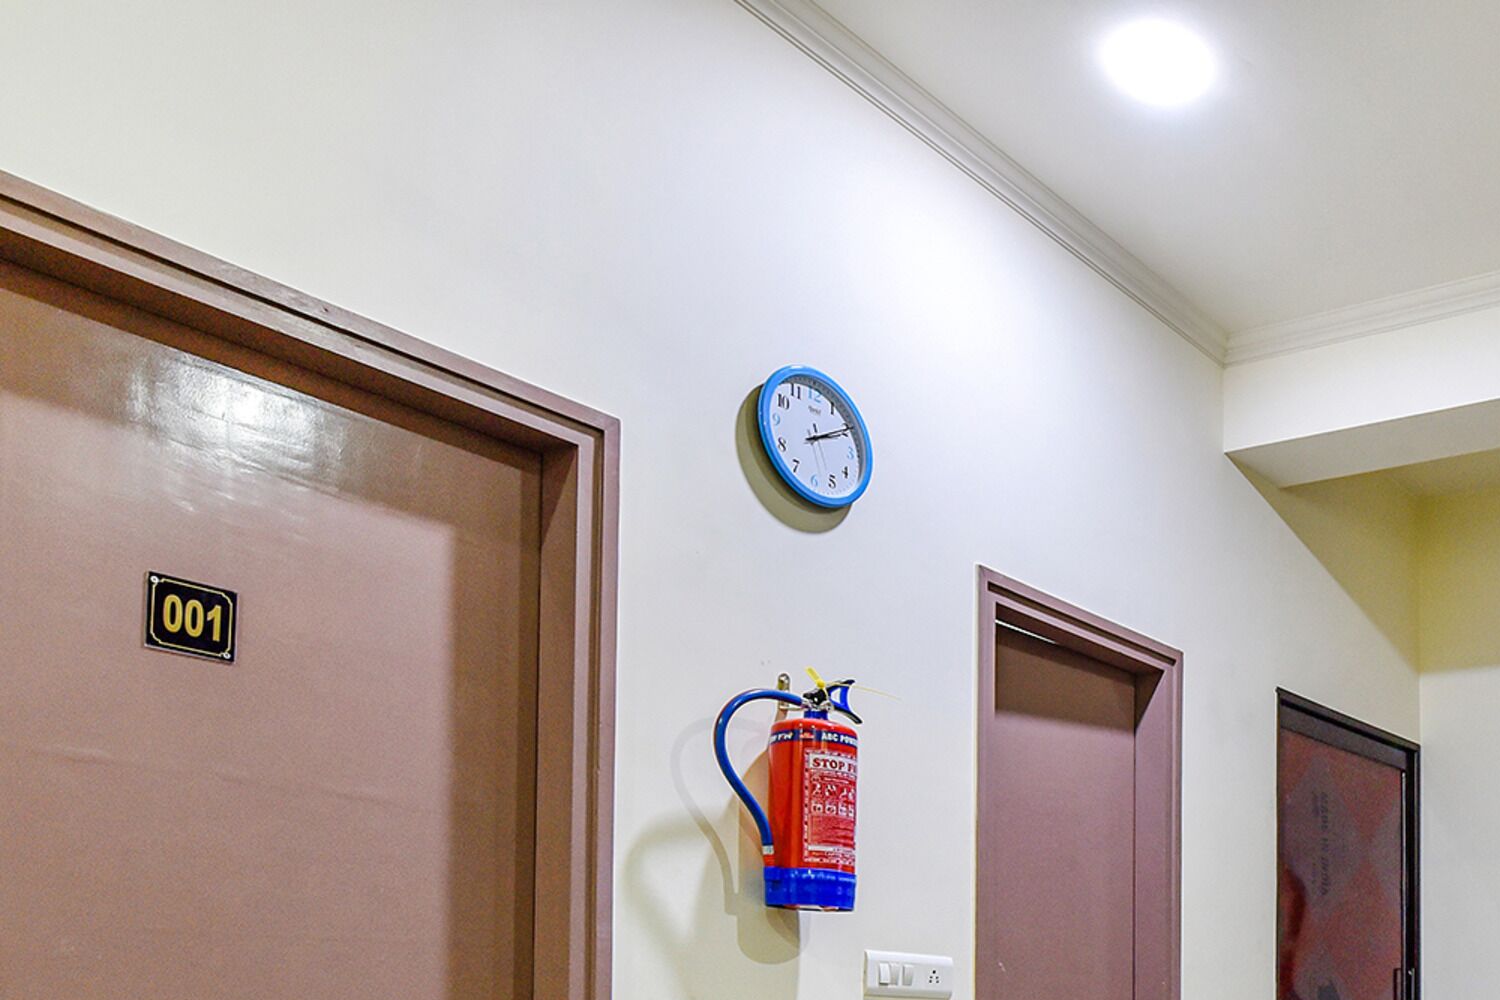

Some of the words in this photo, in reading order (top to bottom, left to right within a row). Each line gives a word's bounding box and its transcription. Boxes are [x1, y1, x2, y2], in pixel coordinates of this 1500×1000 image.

[790, 383, 801, 400] 11
[778, 393, 790, 410] 10
[830, 401, 836, 415] 1
[772, 412, 781, 426] 9
[778, 437, 787, 452] 8
[847, 446, 855, 460] 3
[792, 459, 800, 473] 7
[842, 466, 849, 479] 4
[810, 475, 818, 487] 6
[828, 475, 837, 489] 5
[163, 593, 222, 643] 001
[821, 731, 839, 742] ABC
[812, 757, 845, 771] STOP
